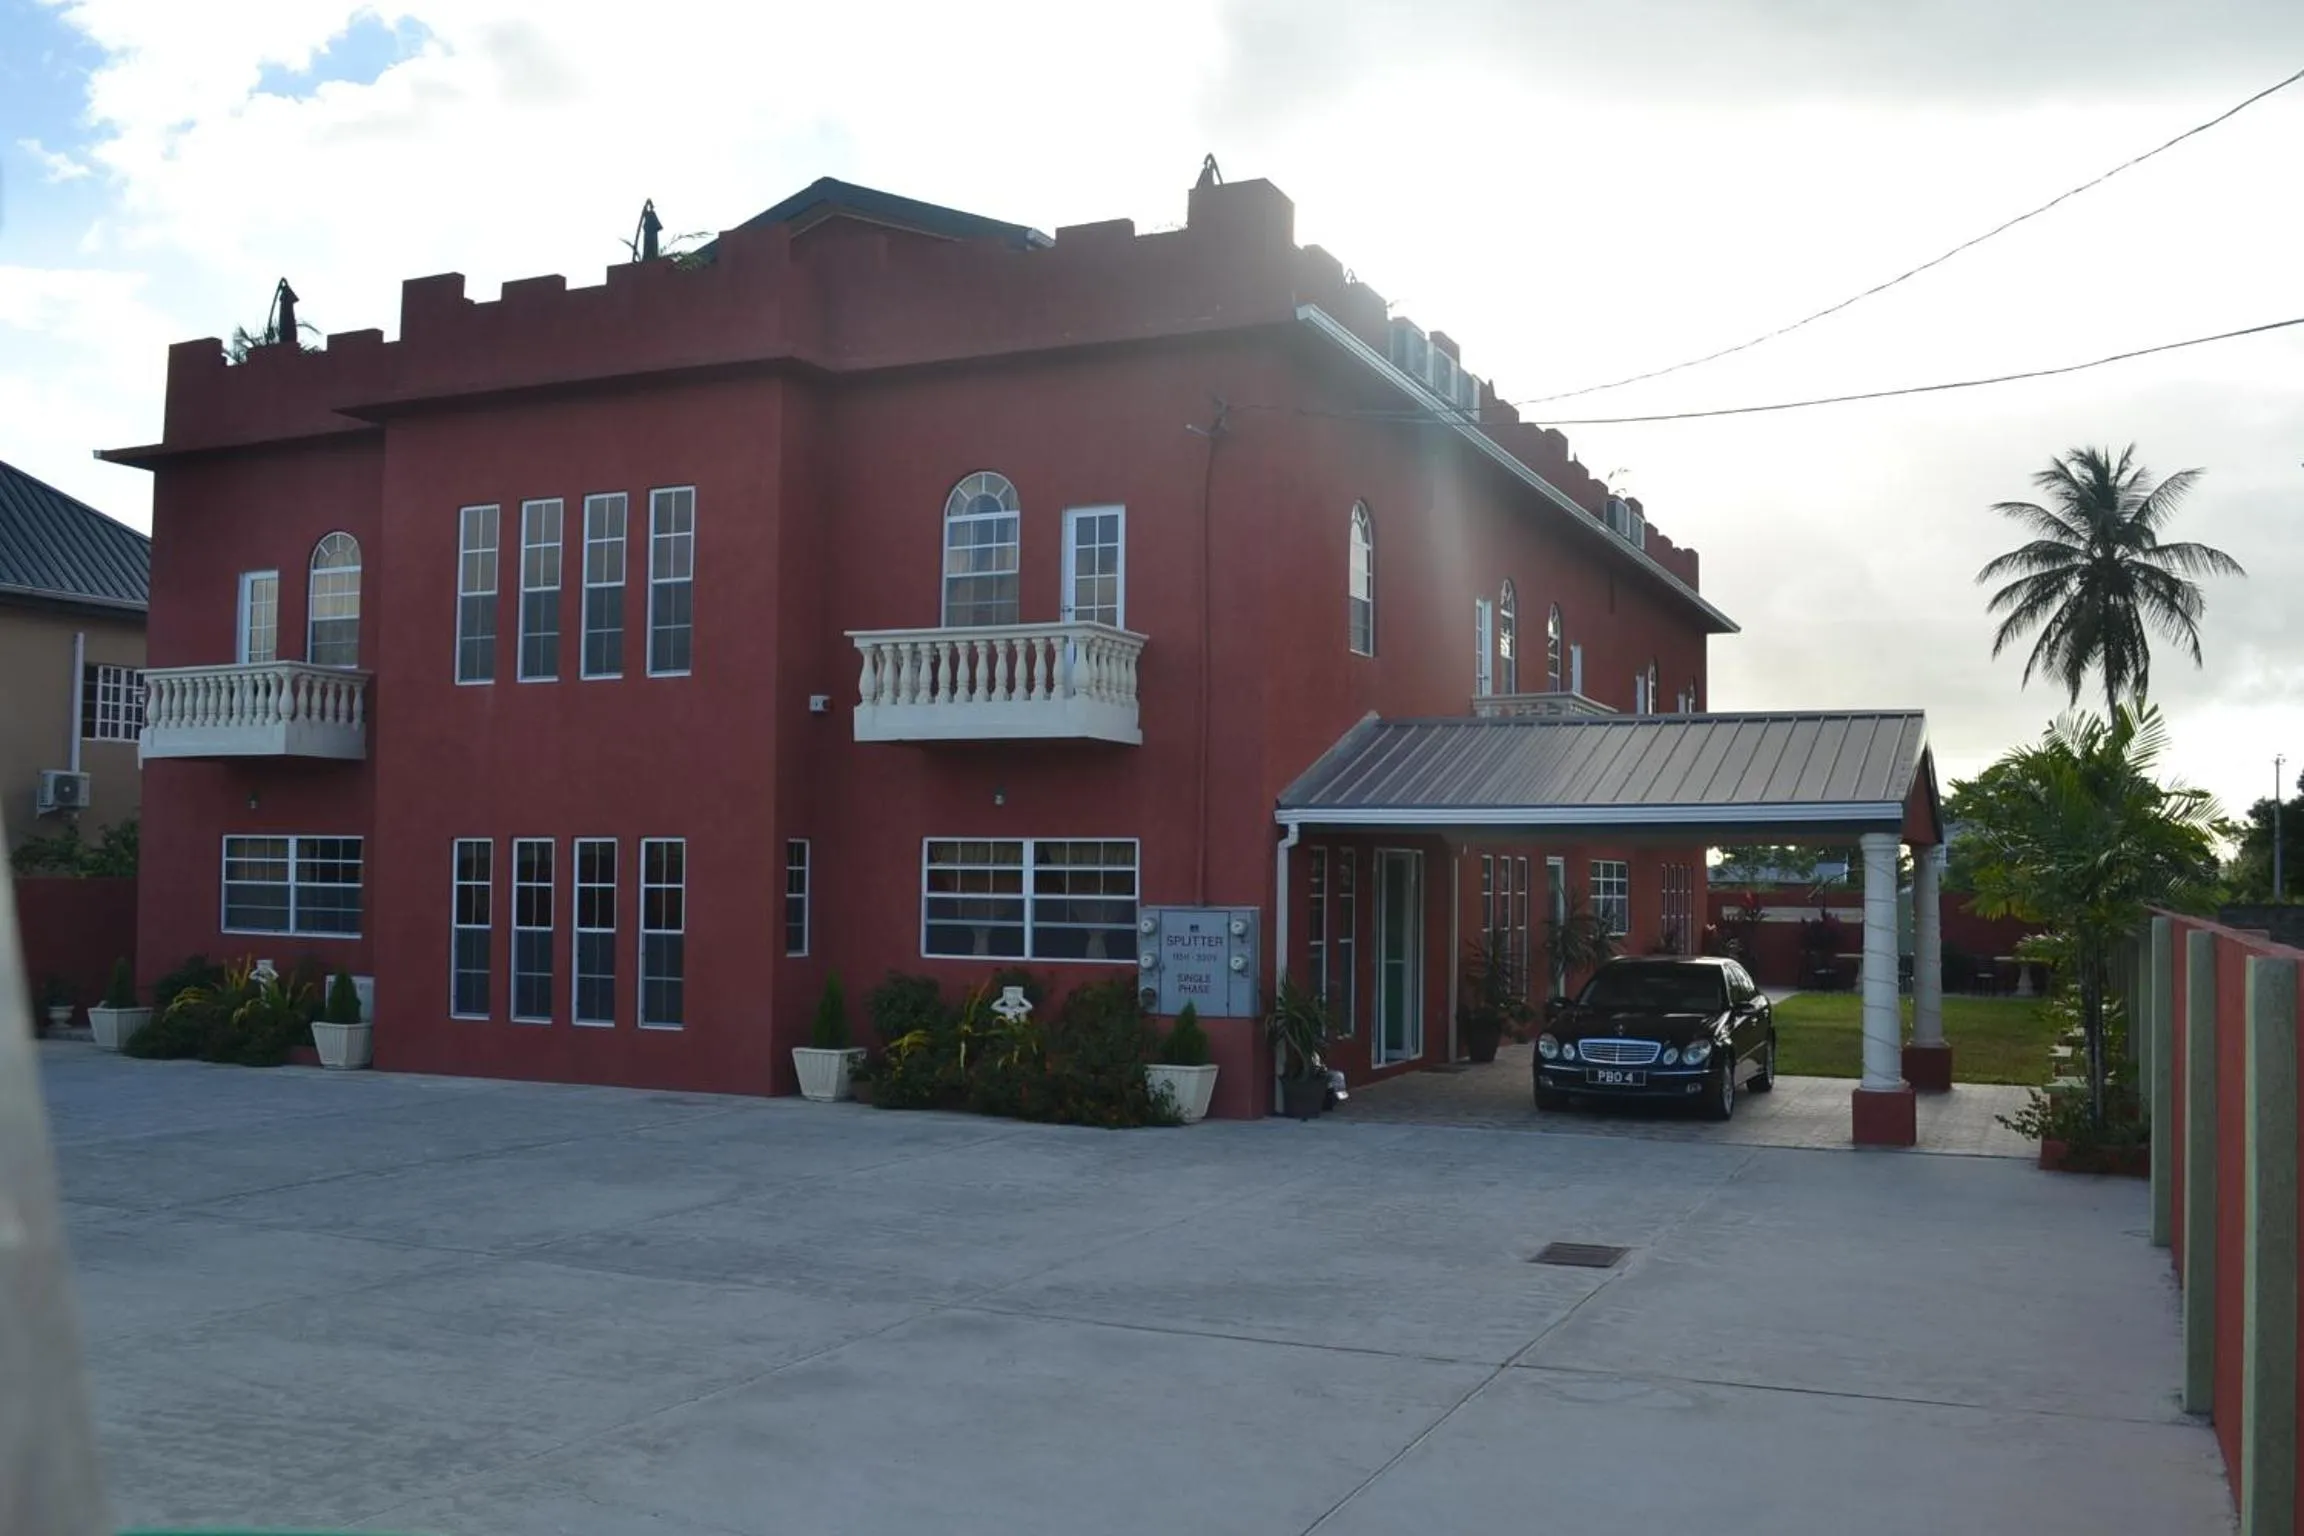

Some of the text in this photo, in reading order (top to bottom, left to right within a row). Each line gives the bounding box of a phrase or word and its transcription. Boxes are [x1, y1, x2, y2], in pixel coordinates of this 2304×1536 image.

[1167, 935, 1223, 947] SPLITTER
[1177, 973, 1211, 983] SINGLE
[1178, 984, 1209, 994] PHASE
[1624, 1071, 1633, 1083] 4
